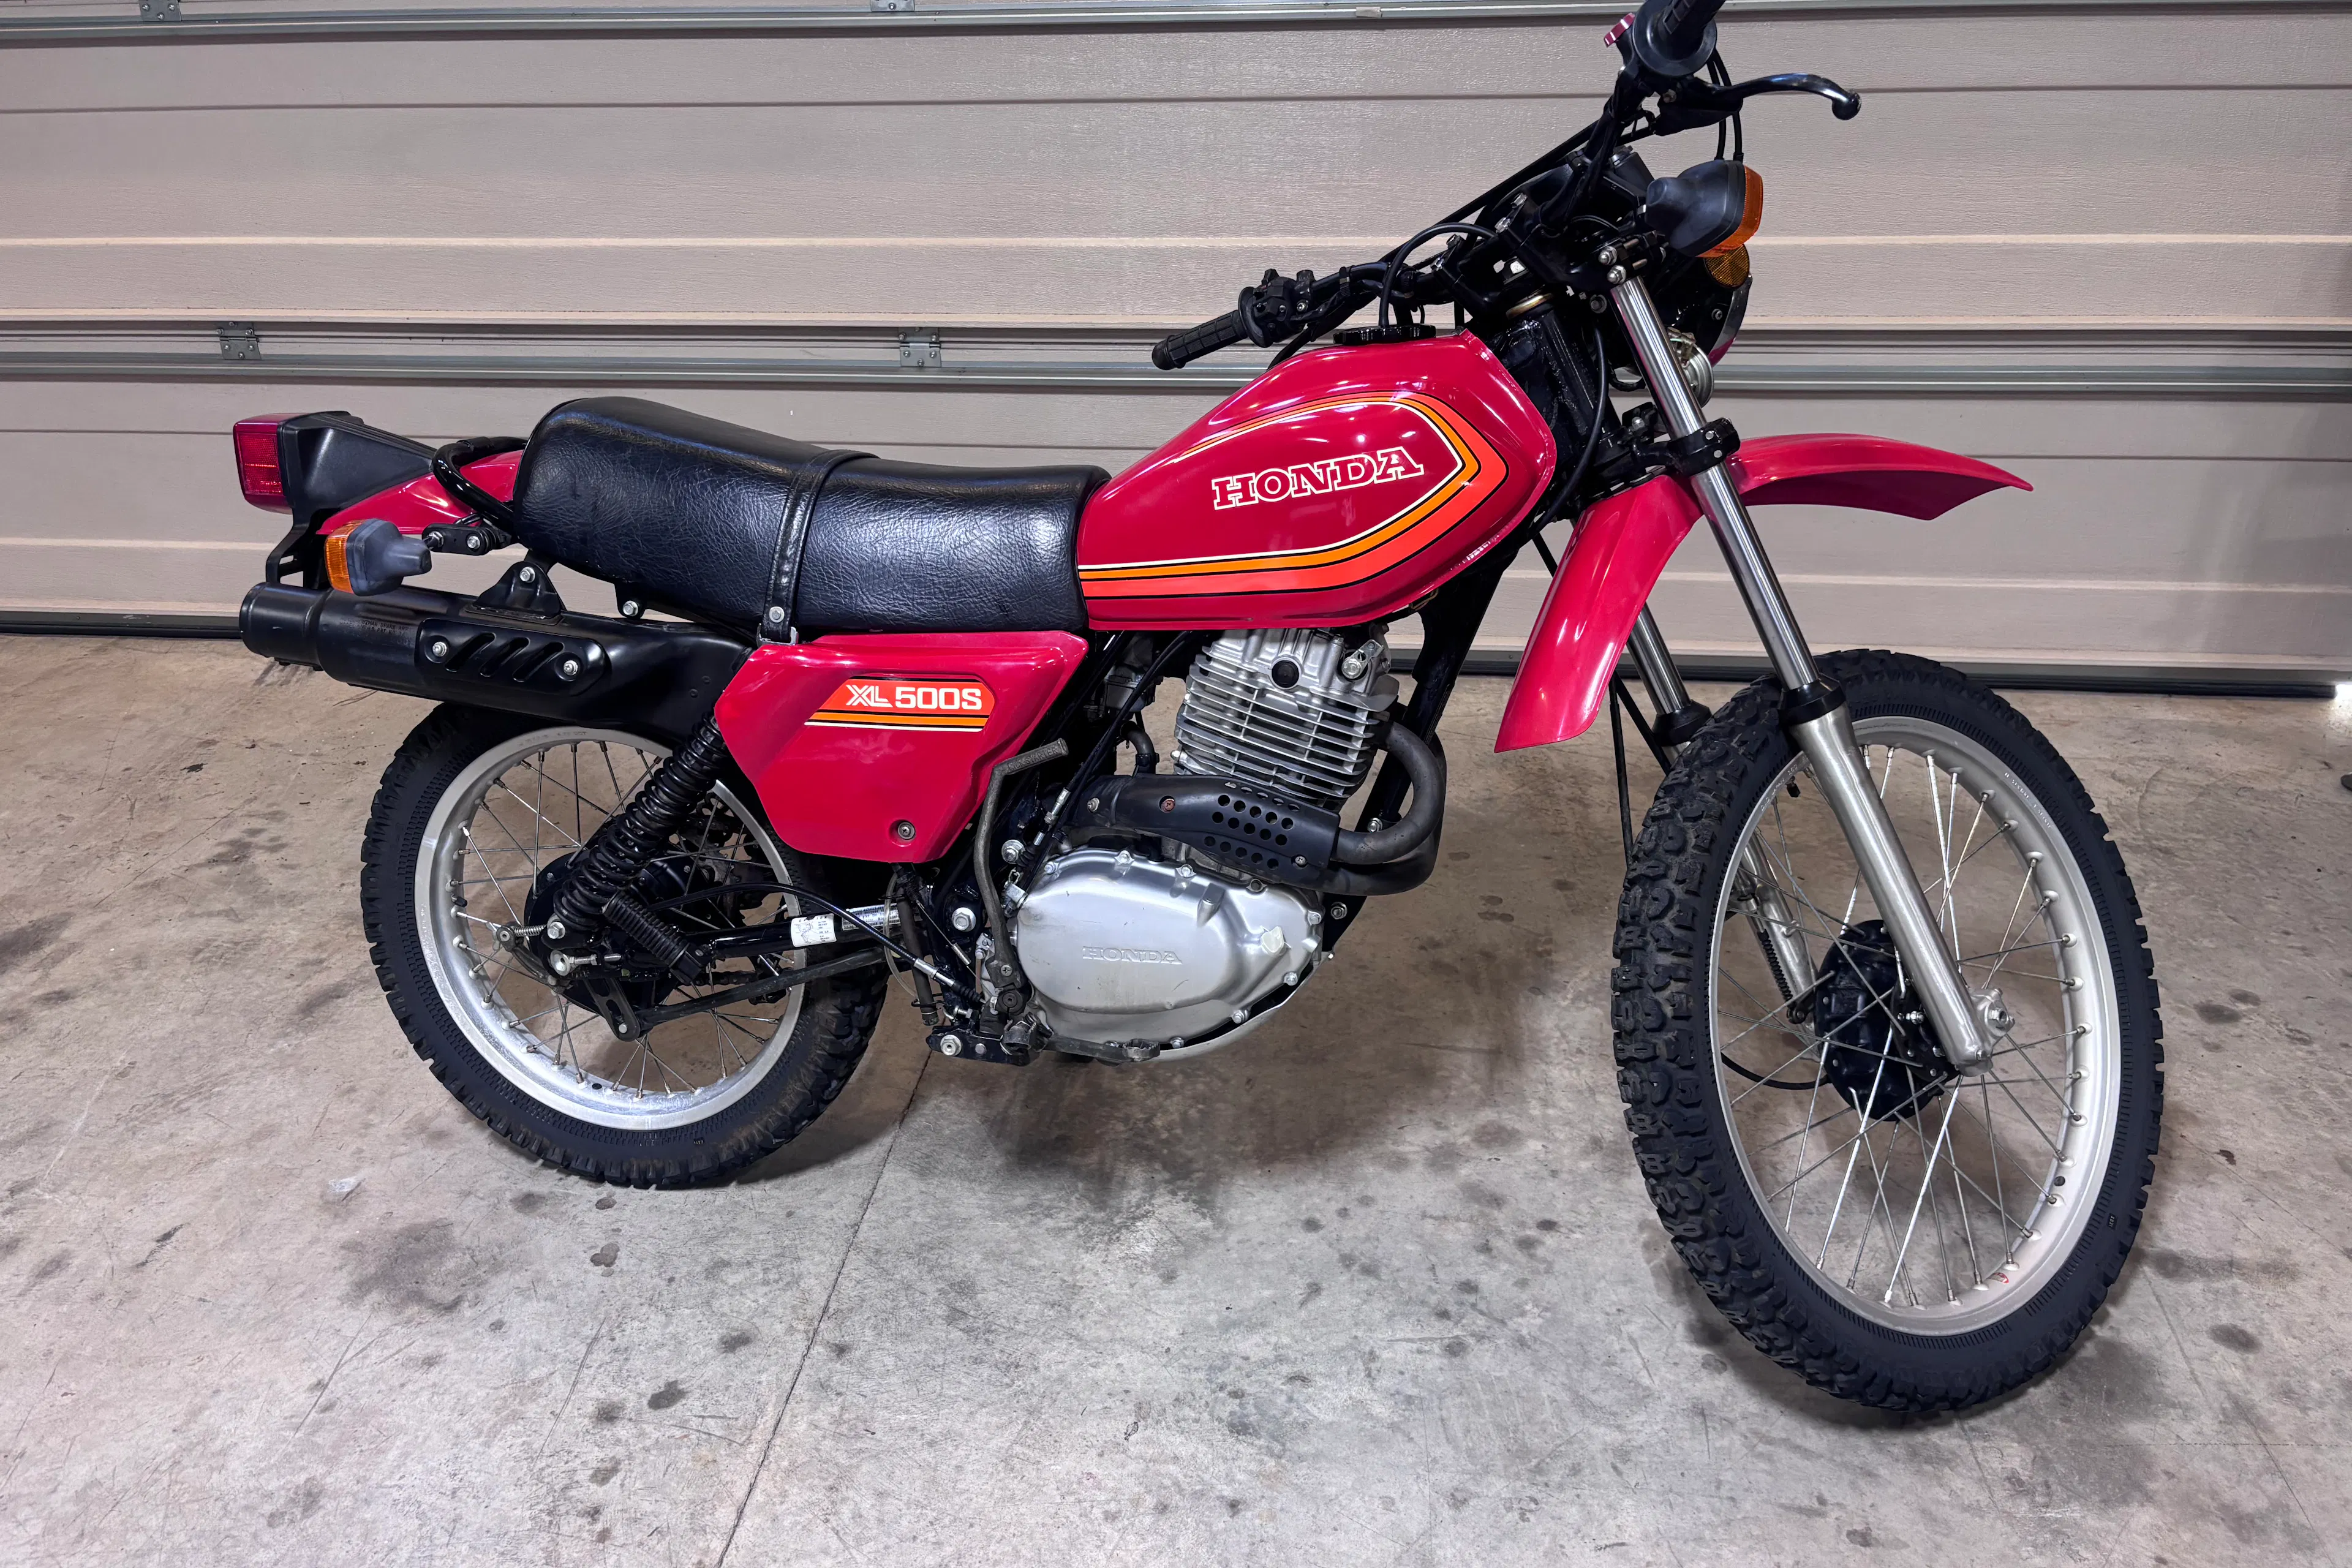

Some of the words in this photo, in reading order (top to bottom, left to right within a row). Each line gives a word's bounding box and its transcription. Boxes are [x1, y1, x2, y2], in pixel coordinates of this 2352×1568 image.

[1212, 446, 1424, 510] HONDA
[846, 685, 893, 707] XL
[895, 687, 982, 710] 500S
[1082, 946, 1183, 965] HONDA
